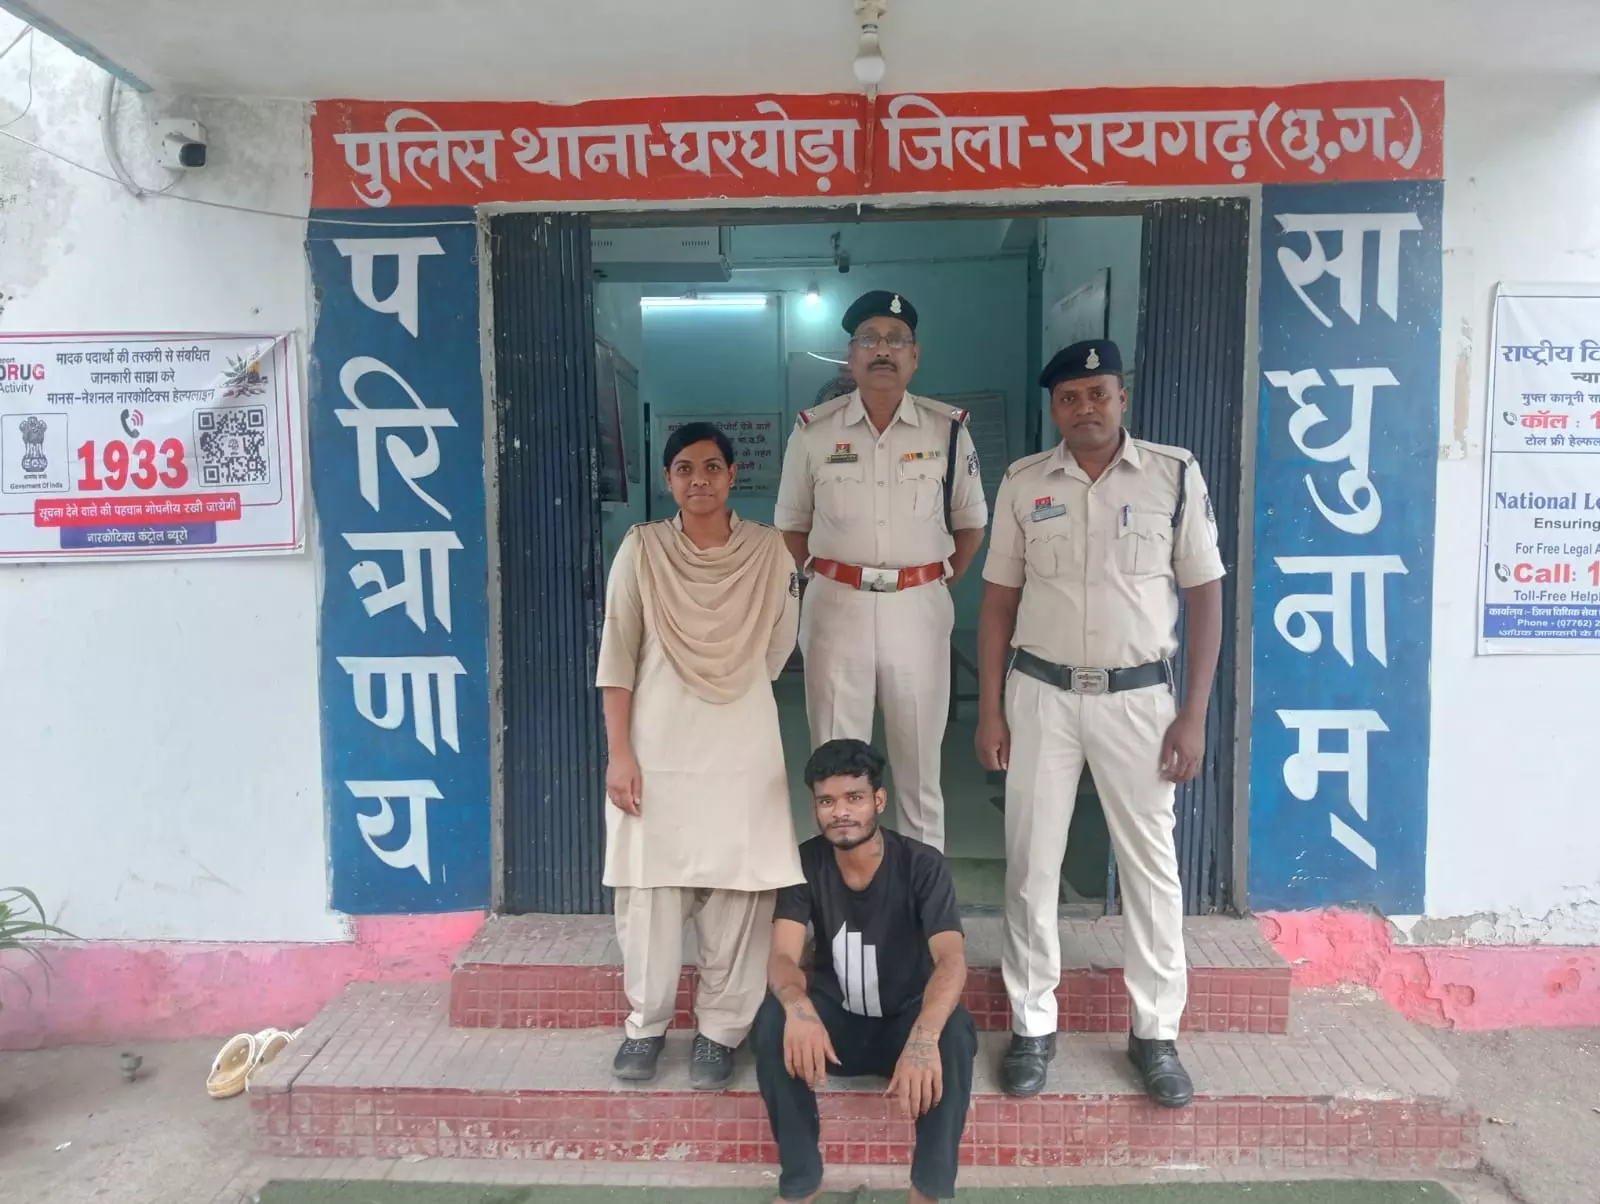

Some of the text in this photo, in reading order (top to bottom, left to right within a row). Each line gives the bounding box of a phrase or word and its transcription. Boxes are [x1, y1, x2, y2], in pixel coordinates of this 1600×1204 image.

[334, 109, 505, 207] पुलिस
[512, 100, 862, 192] थाना-घरघोड़ा
[56, 352, 83, 365] मादक
[117, 347, 129, 364] की
[132, 347, 162, 364] तस्करी
[165, 347, 174, 362] से
[1500, 339, 1574, 366] राष्ट्रीय
[90, 367, 131, 384] जानकारी
[134, 370, 158, 384] साझा
[116, 386, 170, 404] नारकोटिक्स
[172, 386, 215, 403] हेल्पलाइन
[1549, 390, 1584, 406] कानूनी
[1520, 409, 1568, 429] कॉल
[1524, 433, 1547, 446] टोल
[1550, 433, 1565, 446] फ्री
[77, 437, 189, 491] 1933
[50, 480, 63, 489] India
[39, 507, 63, 521] सूचना
[65, 503, 78, 517] देने
[81, 502, 97, 517] वाले
[100, 502, 111, 517] की
[114, 504, 142, 517] पहचान
[145, 500, 180, 515] गोपनीय
[183, 499, 203, 513] रखी
[1494, 492, 1577, 510] National
[1534, 517, 1600, 532] Ensuring
[87, 528, 136, 543] नारकोटिक्स
[167, 526, 188, 544] ब्यूरो
[1515, 542, 1534, 554] For
[1537, 542, 1560, 554] Free
[1563, 543, 1592, 557] Legal
[333, 236, 467, 885] परित्राणाय
[1513, 560, 1600, 586] Call: 1
[1513, 590, 1567, 601] Toll-Free
[1532, 605, 1552, 616] जिला
[1581, 606, 1597, 616] सेवा
